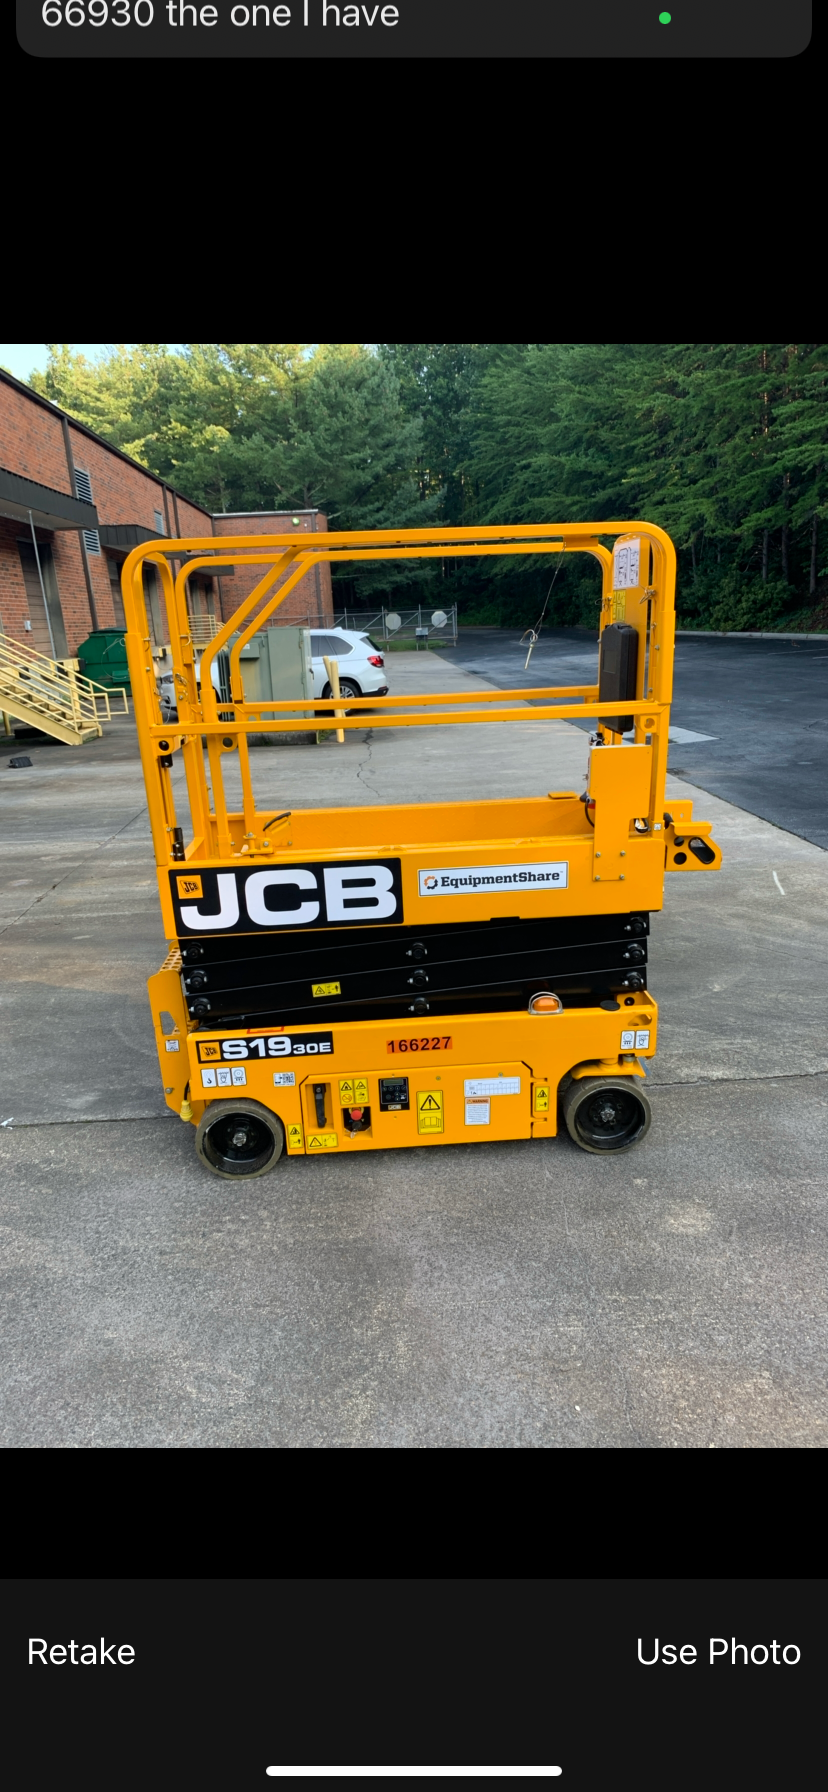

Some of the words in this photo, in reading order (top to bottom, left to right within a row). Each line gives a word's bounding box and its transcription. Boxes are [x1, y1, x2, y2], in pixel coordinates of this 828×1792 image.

[440, 870, 560, 888] EquipmentShare
[179, 865, 398, 930] JCB
[387, 1036, 451, 1053] 166227
